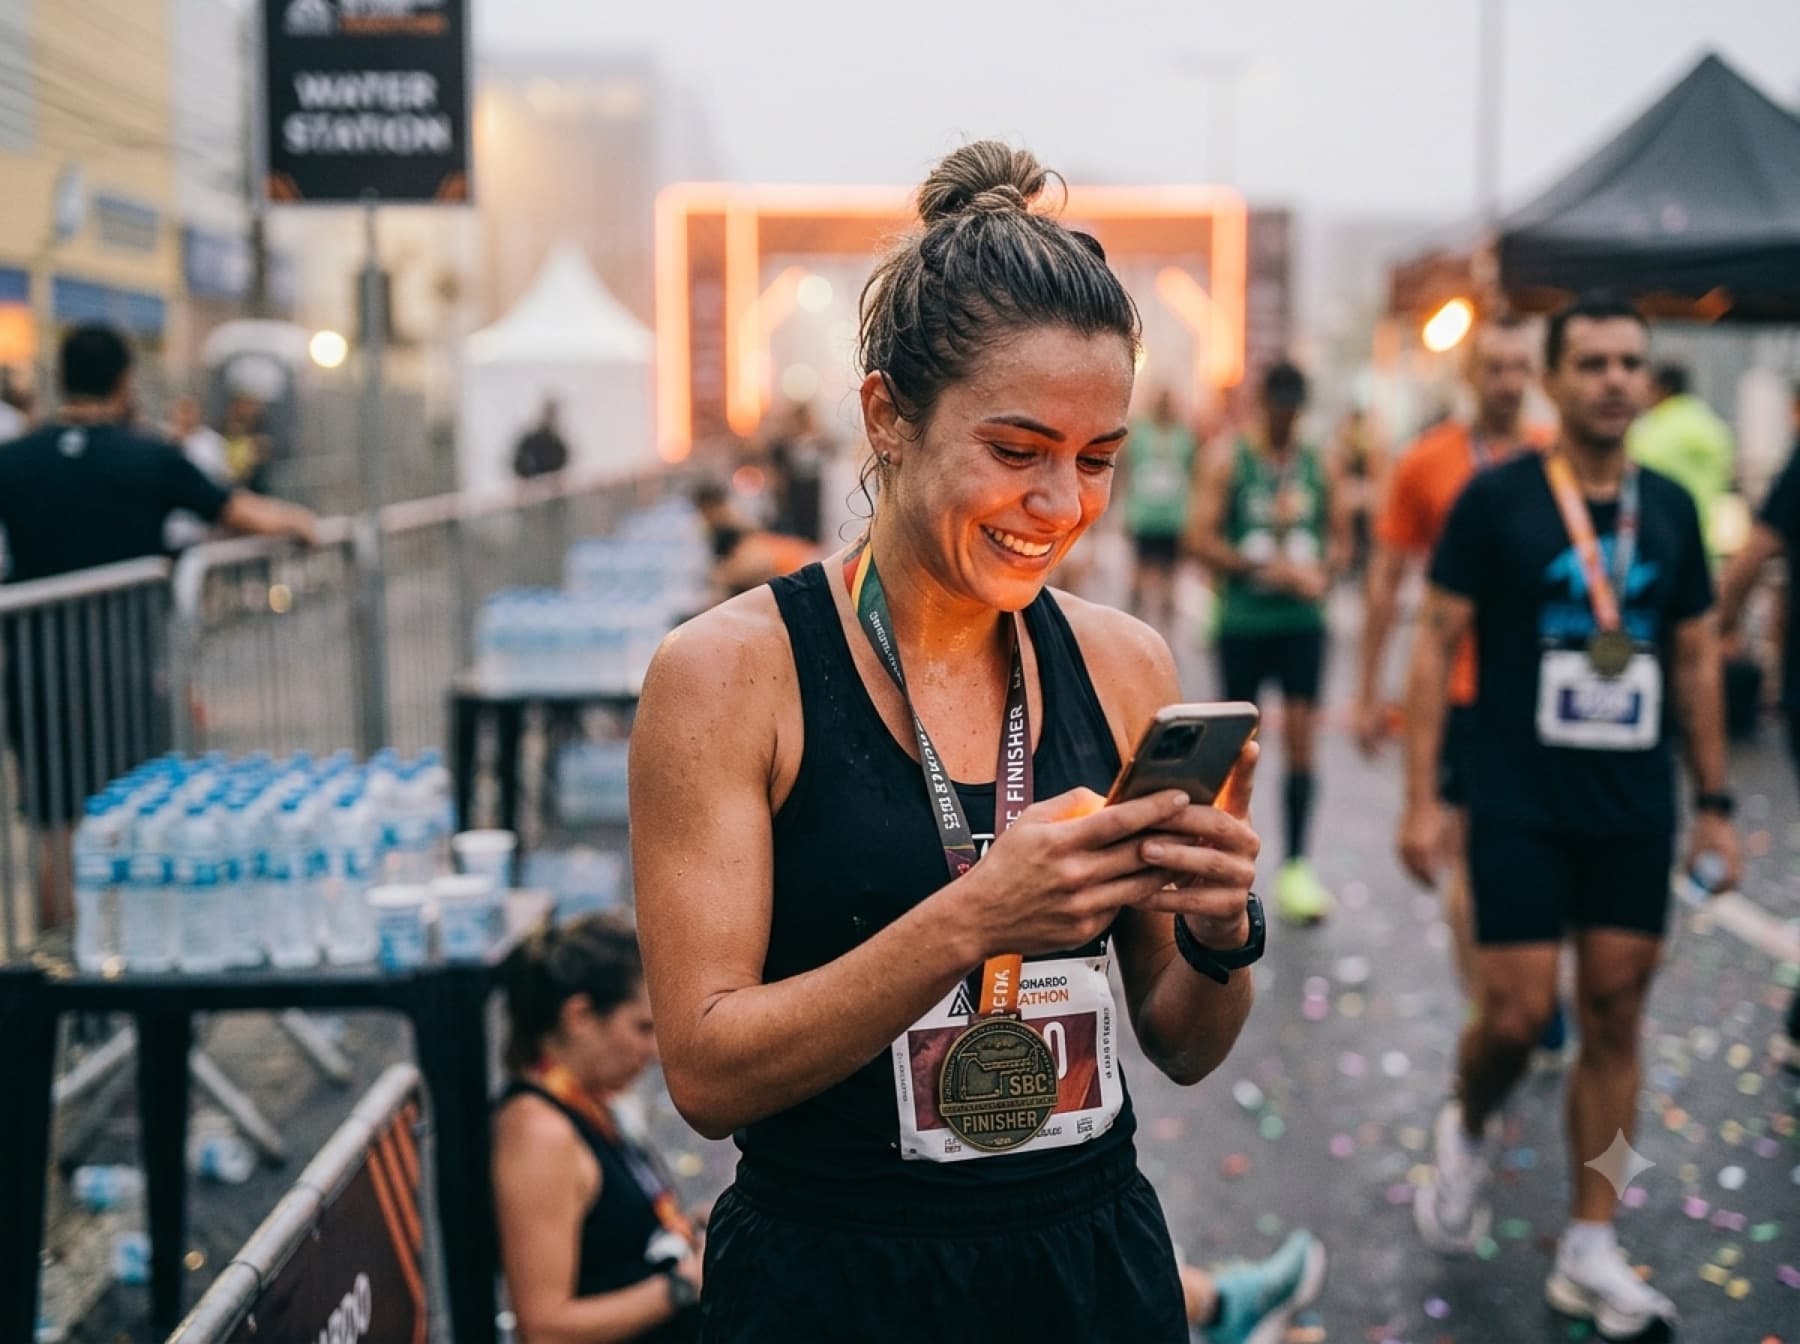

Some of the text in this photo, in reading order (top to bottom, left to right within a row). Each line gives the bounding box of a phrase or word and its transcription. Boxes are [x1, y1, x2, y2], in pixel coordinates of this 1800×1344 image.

[293, 71, 438, 110] WATER
[283, 111, 451, 154] STATION
[1007, 704, 1024, 802] FINISHER
[1020, 976, 1068, 990] ONARDO
[1020, 988, 1069, 1006] ATHON
[1009, 1073, 1047, 1096] SBC
[962, 1111, 1038, 1134] FINISHER
